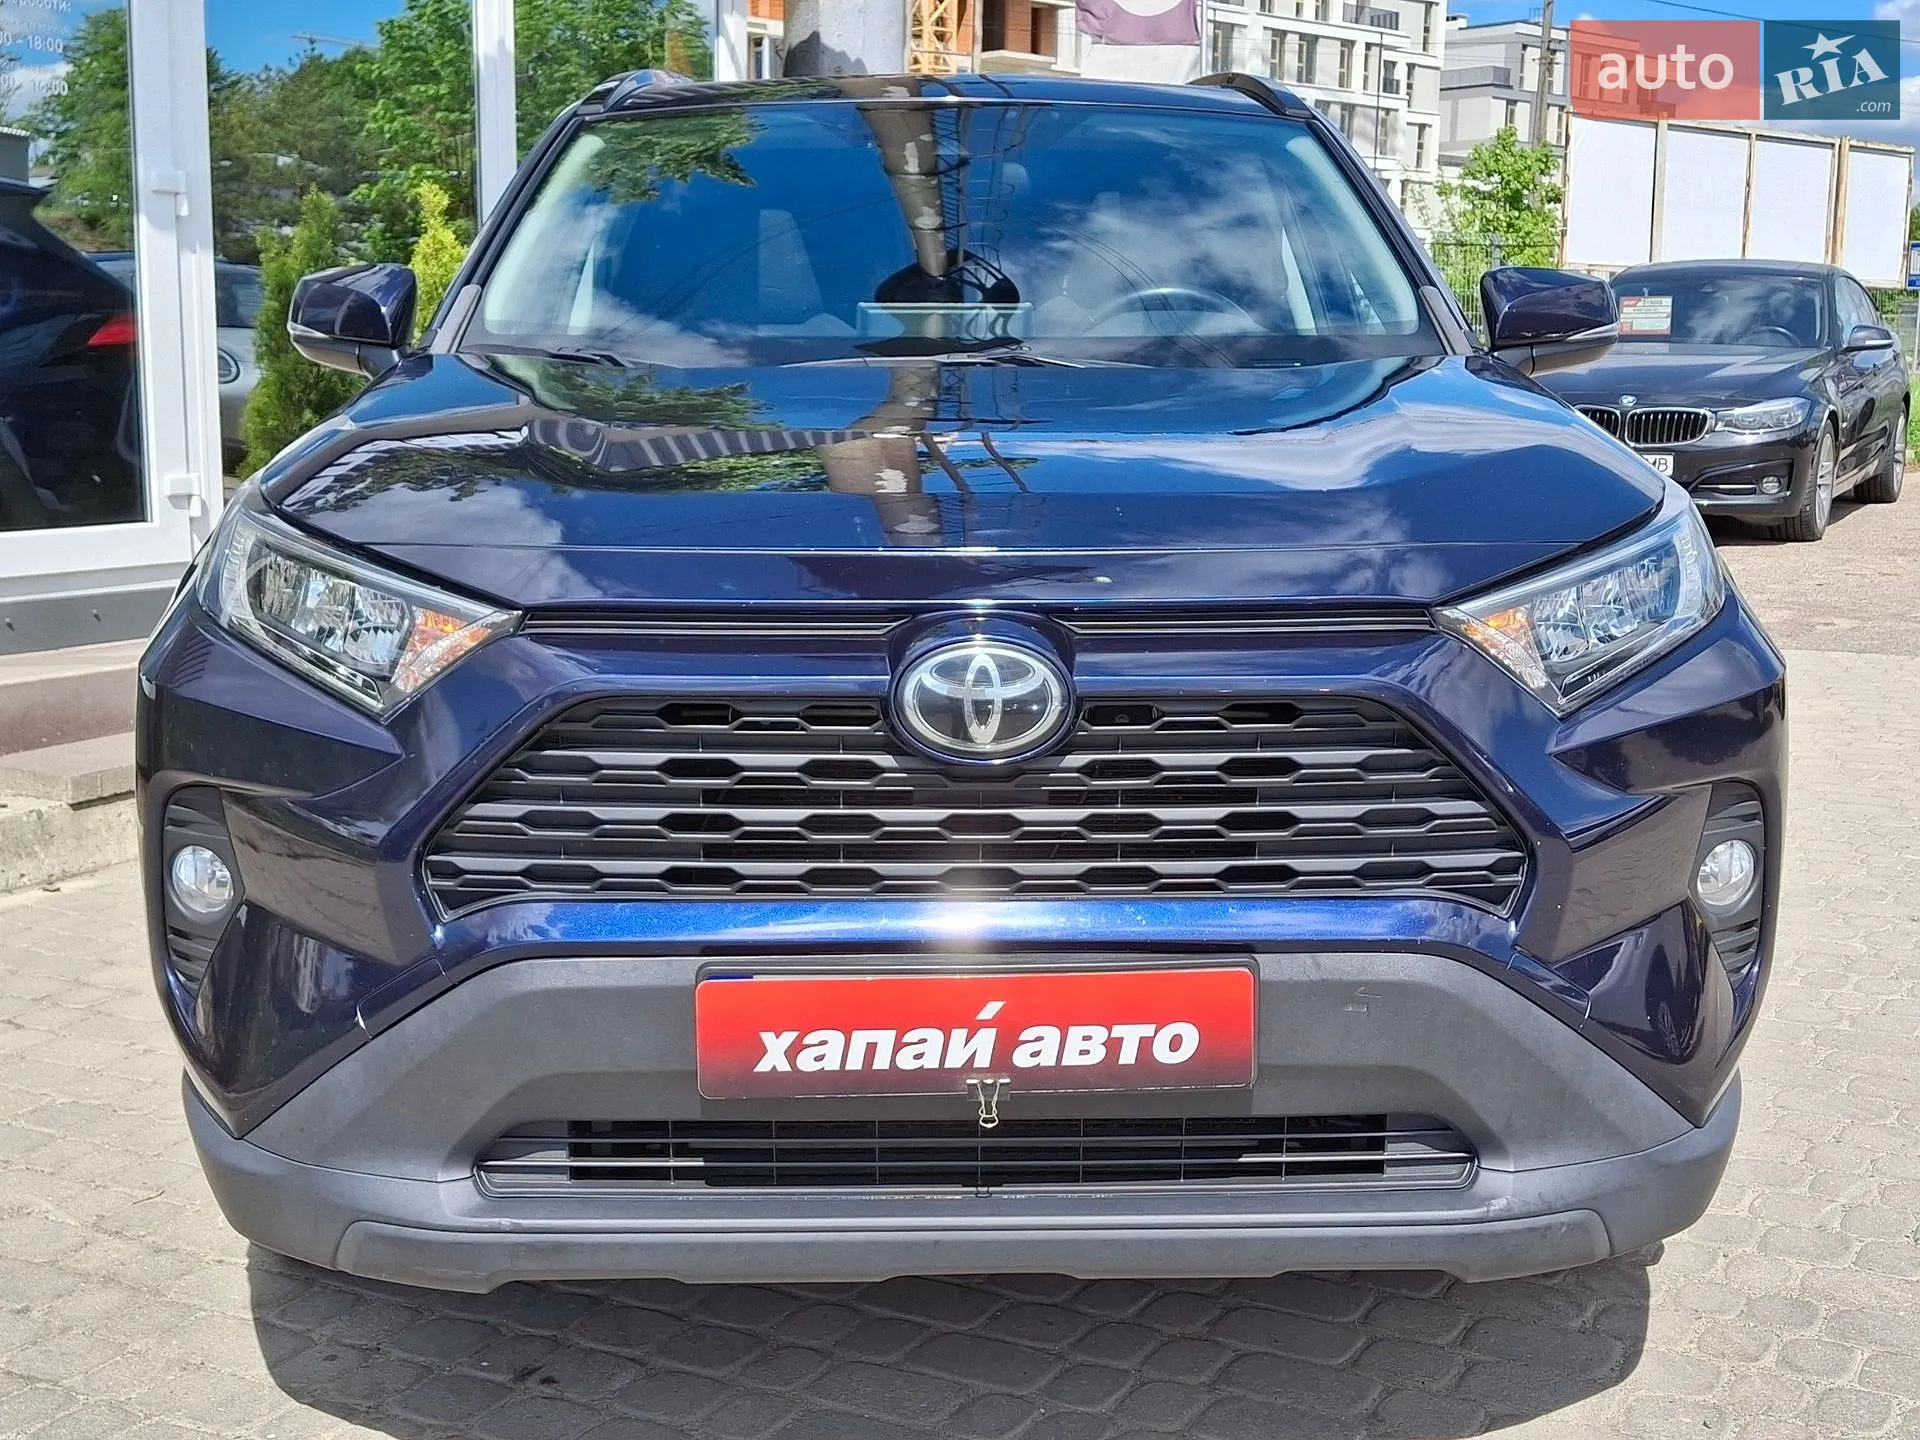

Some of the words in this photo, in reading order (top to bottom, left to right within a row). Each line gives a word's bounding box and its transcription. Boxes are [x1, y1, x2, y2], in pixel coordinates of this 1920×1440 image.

[27, 35, 64, 53] 18:00
[753, 1001, 1006, 1073] хапай
[1012, 1020, 1201, 1068] авто
